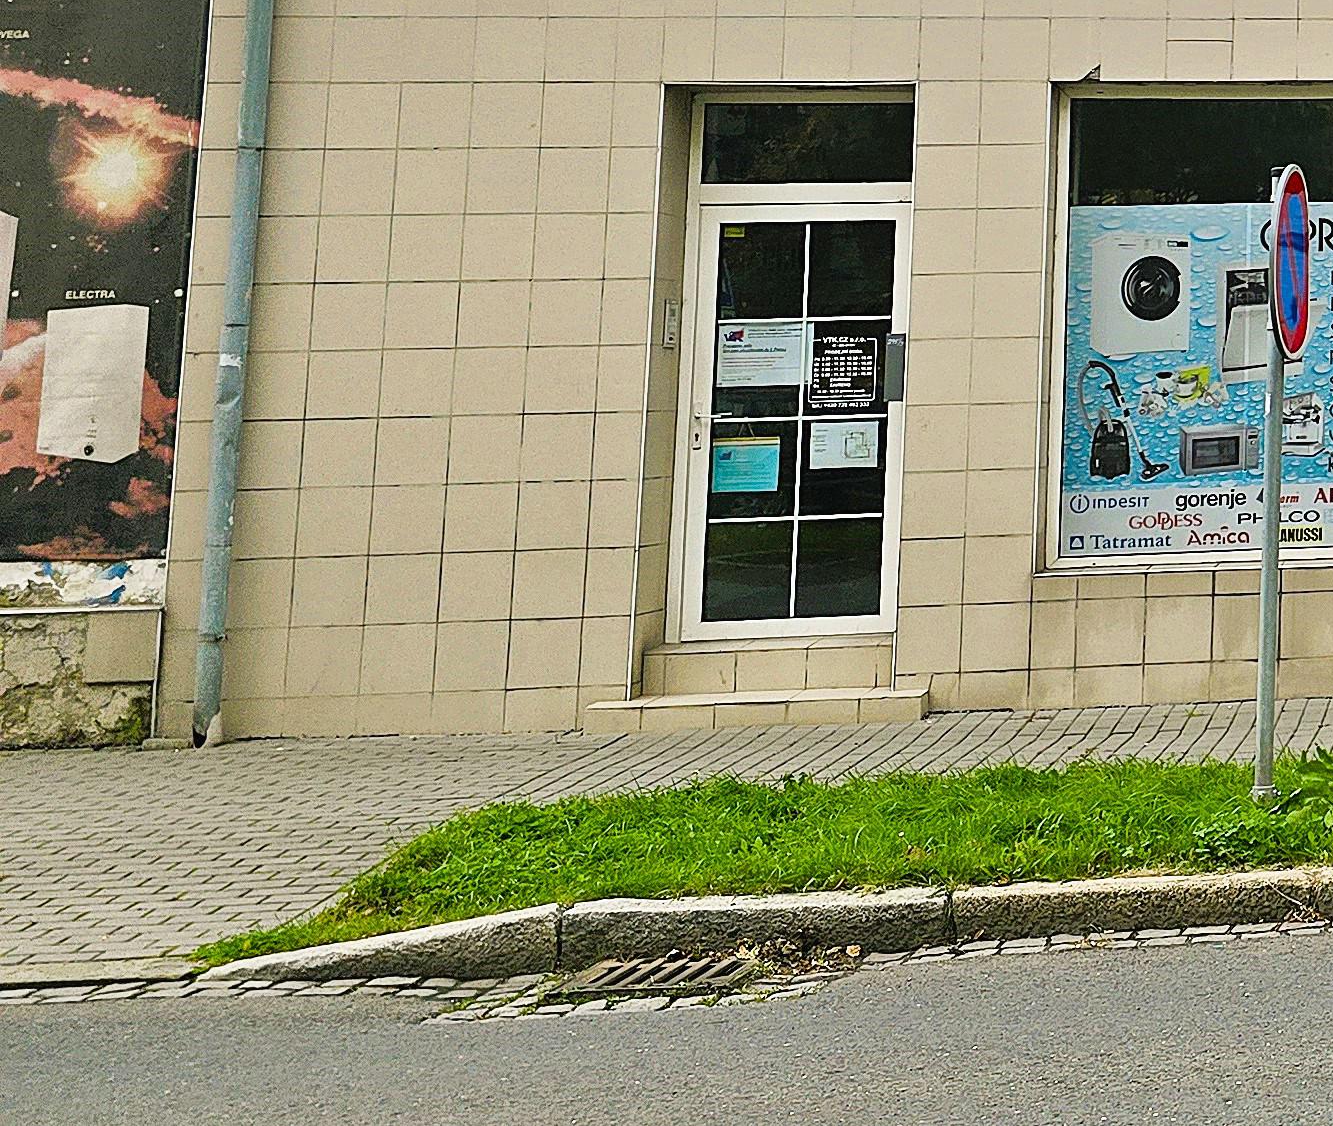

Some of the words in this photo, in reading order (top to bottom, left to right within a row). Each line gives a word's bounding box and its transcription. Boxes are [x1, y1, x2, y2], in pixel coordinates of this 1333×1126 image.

[65, 289, 116, 300] ELECTRA
[1175, 489, 1247, 511] gorenje
[1128, 511, 1203, 530] GODDESS
[1237, 509, 1321, 525] PHLCO
[1090, 534, 1172, 550] Tatramat
[1186, 526, 1250, 546] Amica
[1279, 527, 1323, 542] ANUSSI
